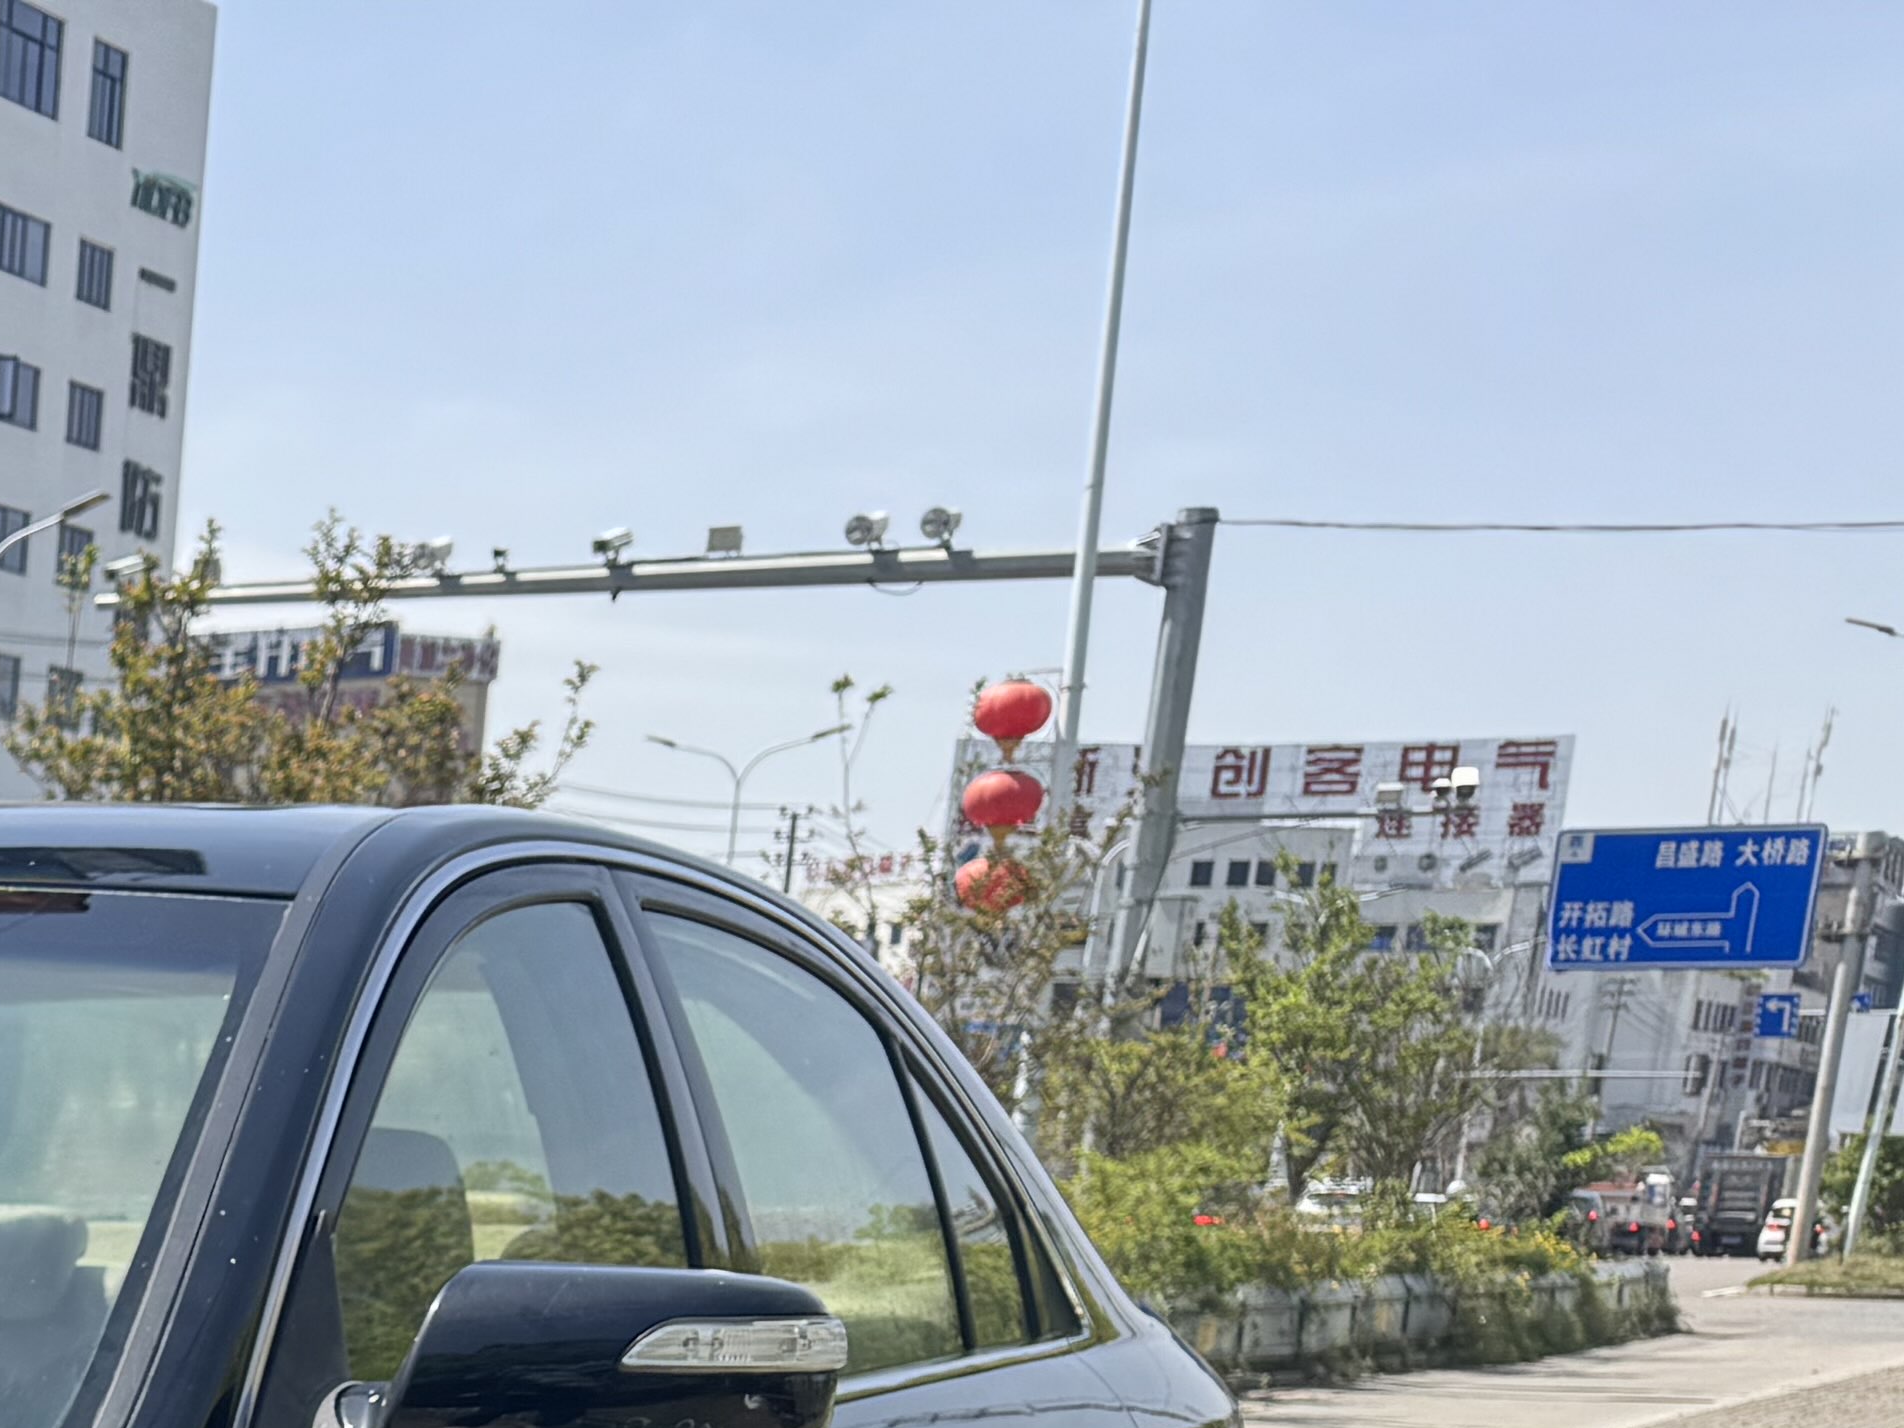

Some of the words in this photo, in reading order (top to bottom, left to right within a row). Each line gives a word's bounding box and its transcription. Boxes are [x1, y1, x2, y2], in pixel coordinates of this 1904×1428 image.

[1072, 740, 1558, 799] 创客电气
[1375, 803, 1546, 839] 连接器
[1655, 840, 1724, 869] 昌盛路
[1735, 836, 1810, 866] 大桥路
[1558, 901, 1635, 929] 开拓路
[1557, 933, 1633, 961] 长虹村
